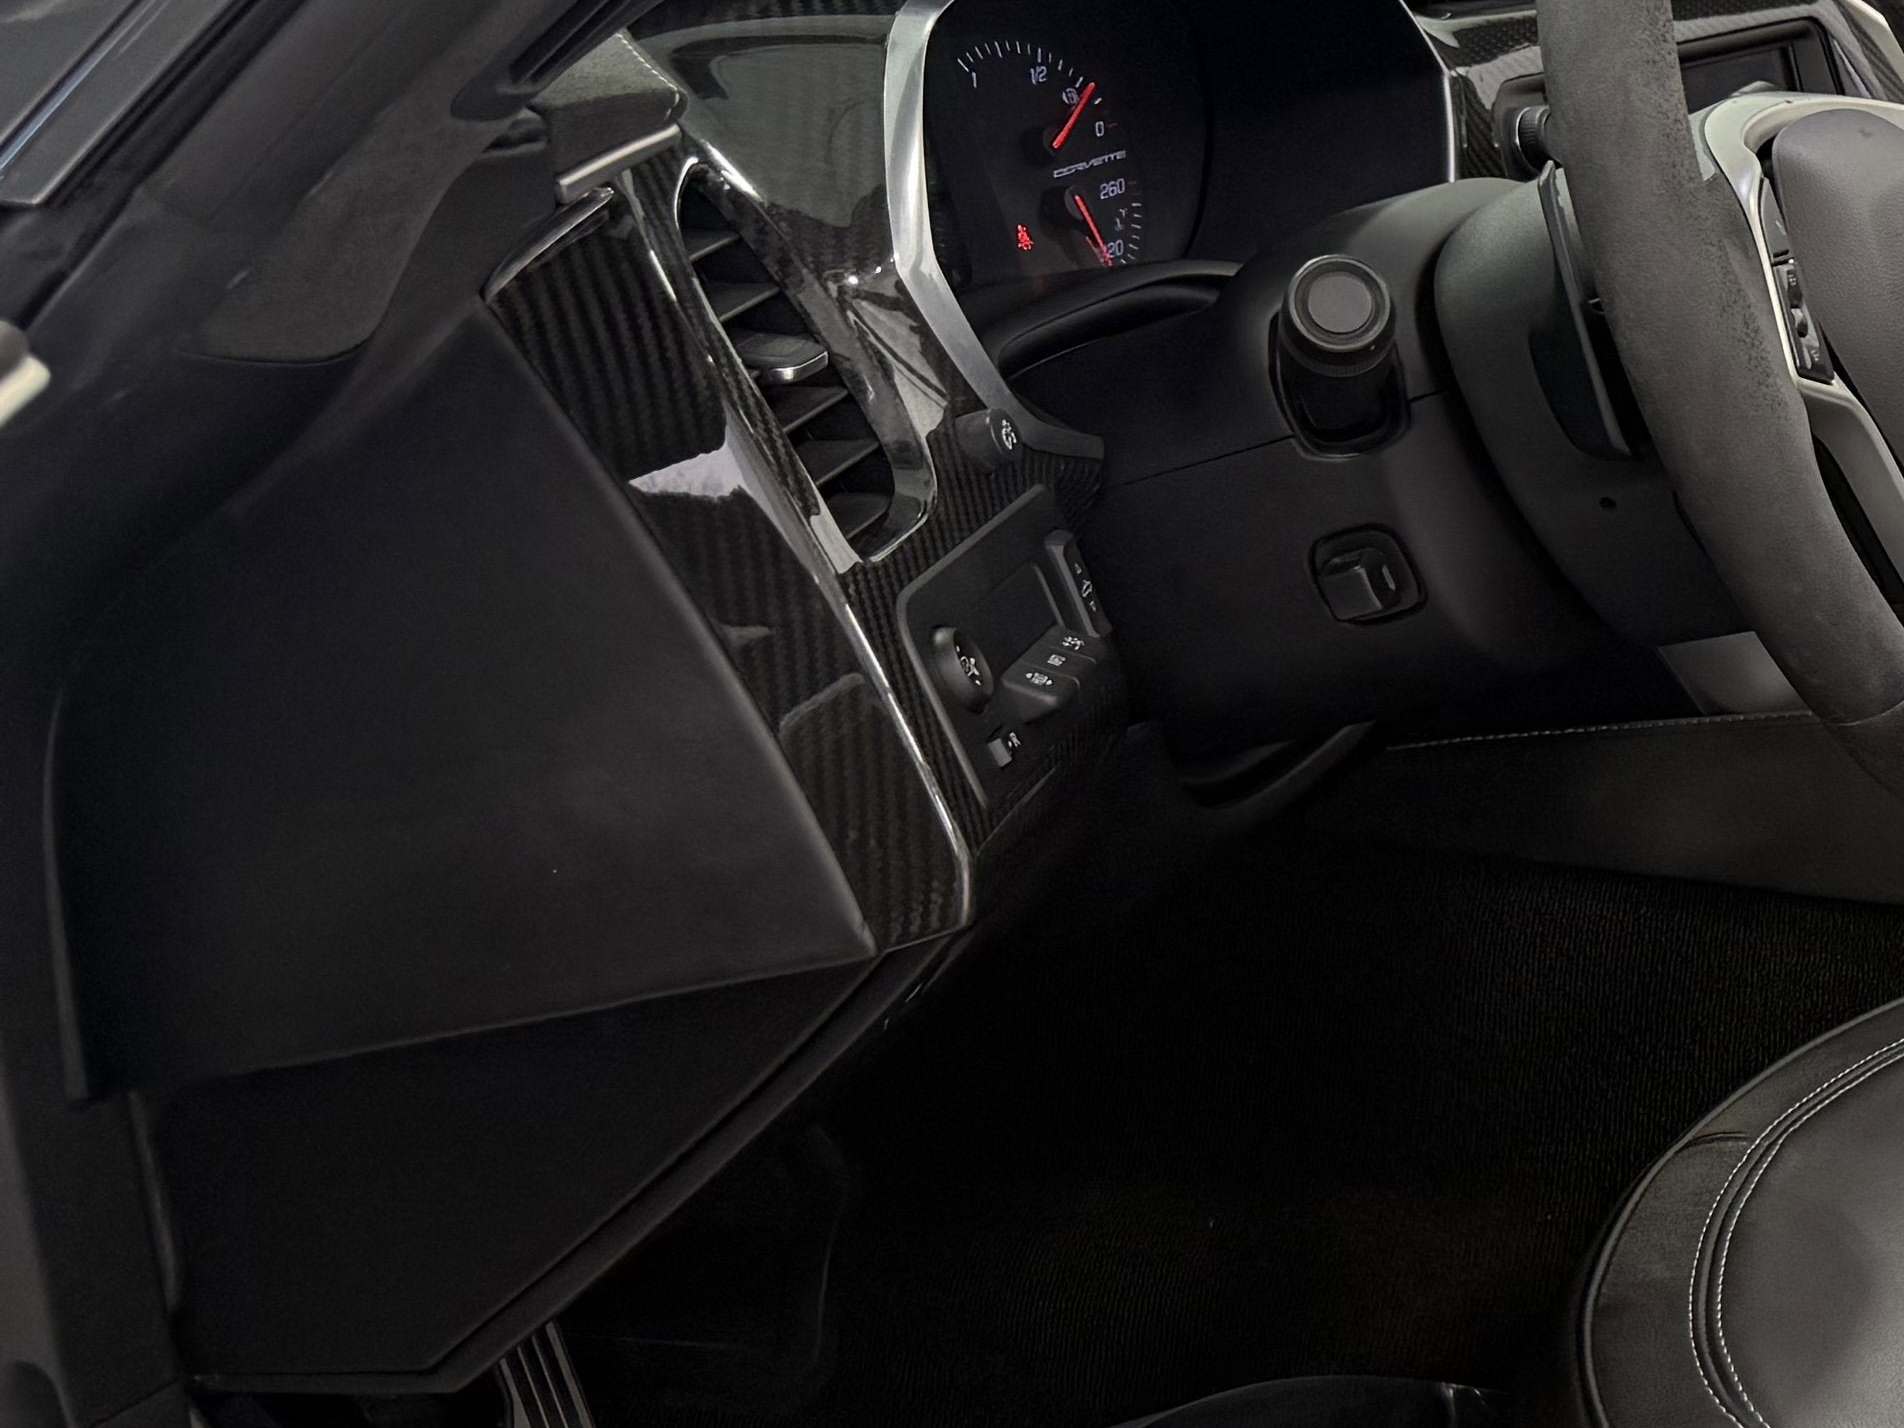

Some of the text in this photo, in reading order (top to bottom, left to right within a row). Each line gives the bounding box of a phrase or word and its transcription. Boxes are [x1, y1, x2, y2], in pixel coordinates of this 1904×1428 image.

[1095, 120, 1105, 137] 0
[1053, 149, 1127, 178] CORVETTE
[1100, 177, 1126, 200] 260
